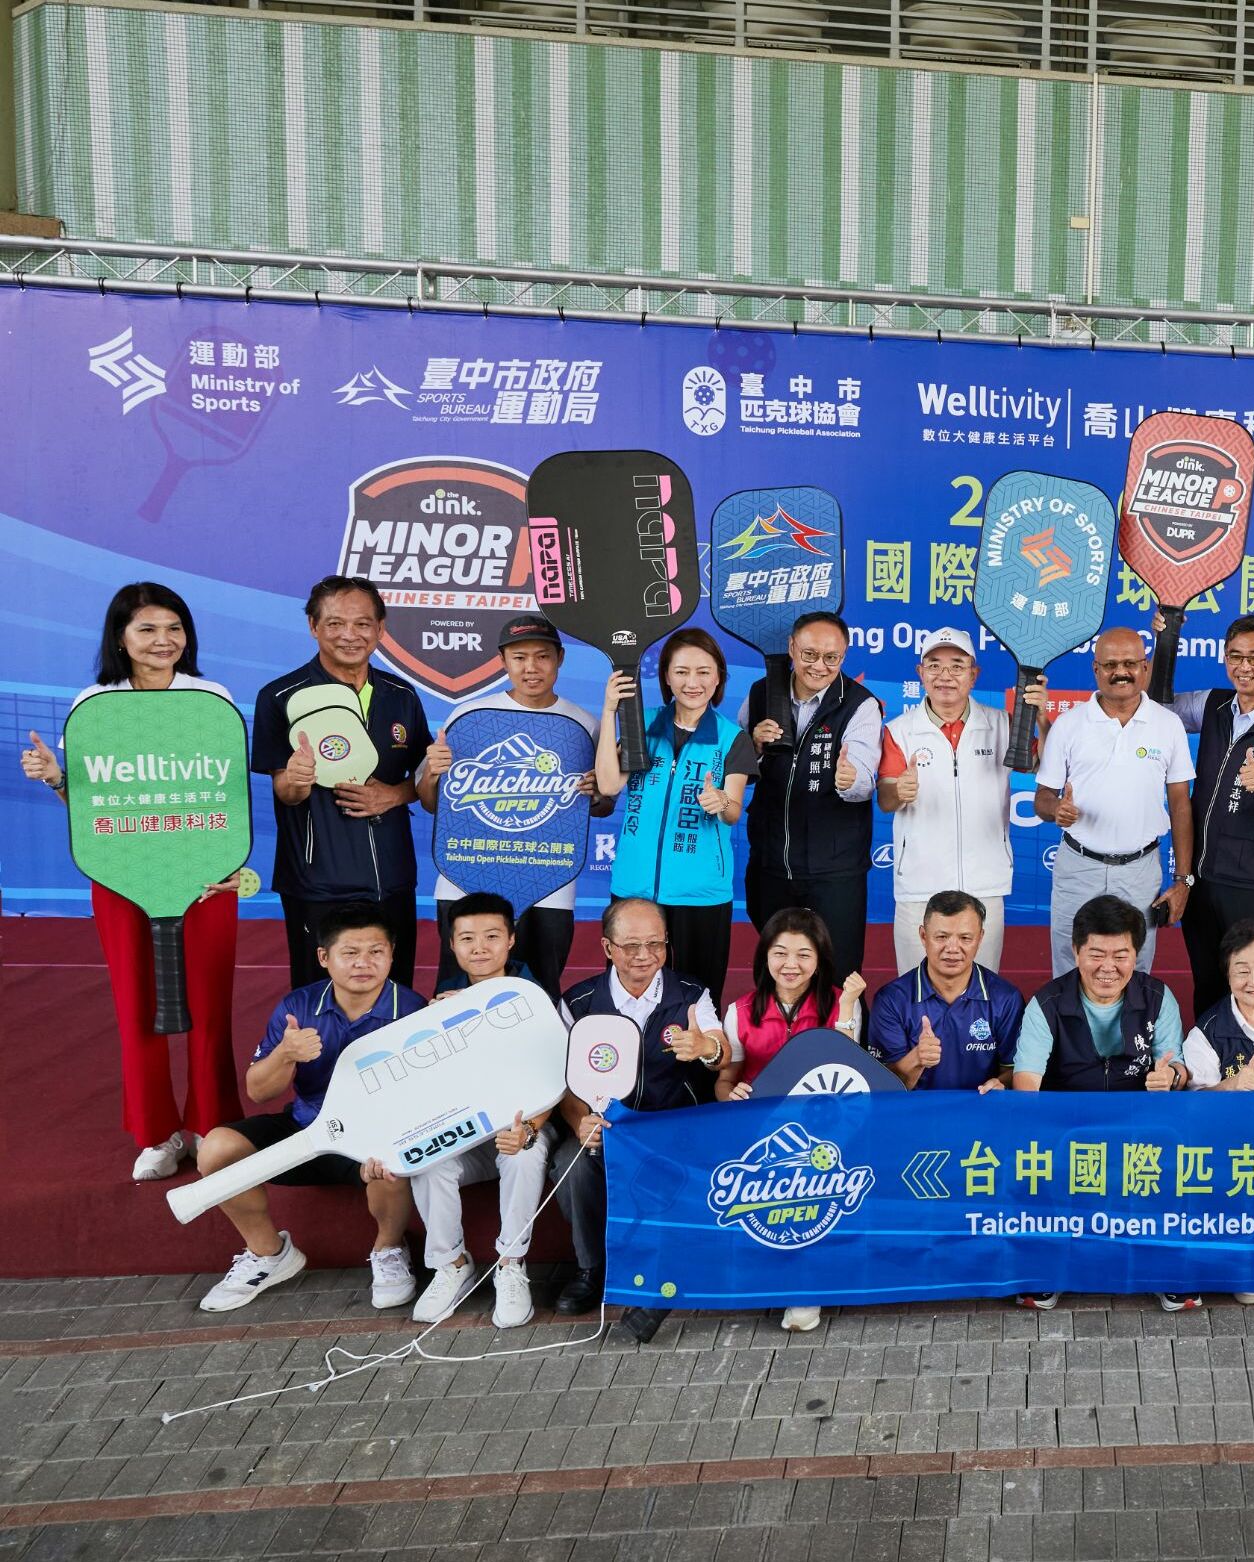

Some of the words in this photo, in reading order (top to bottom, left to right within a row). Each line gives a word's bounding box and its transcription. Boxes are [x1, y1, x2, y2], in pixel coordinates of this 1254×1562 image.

[189, 341, 280, 370] 運動部
[191, 374, 275, 396] Ministry
[279, 379, 300, 395] of
[420, 358, 603, 391] 臺中市政府
[740, 372, 862, 401] 臺中市
[191, 394, 261, 413] Sports
[416, 393, 466, 403] SPORTS
[440, 404, 491, 414] BUREAU
[490, 391, 600, 425] 運動局
[917, 382, 1062, 428] Welltivity
[740, 399, 861, 426] 匹克球協會
[690, 419, 719, 434] TXG
[740, 425, 775, 435] Taichung
[777, 427, 814, 436] Pickleball
[816, 428, 861, 438] Association
[922, 429, 1055, 447] 數位大健康生活平台
[1141, 468, 1218, 494] MINOR
[1136, 485, 1213, 509] LEAGUE
[1144, 504, 1187, 516] CHINESE
[1190, 510, 1223, 521] TAIPEI
[351, 519, 513, 558] MINOR
[988, 496, 1044, 566] MINISTRY
[1049, 498, 1077, 517] OF
[1074, 512, 1105, 586] SPORTS
[1166, 527, 1196, 540] DUPR
[346, 553, 508, 586] LEAGUE
[724, 562, 834, 592] 臺中市政府
[382, 592, 456, 606] HINESE
[465, 594, 533, 609] TAIPEI
[722, 590, 753, 599] SPORTS
[736, 594, 767, 604] BUREAU
[766, 580, 832, 605] 運動局
[1010, 591, 1069, 618] 運動部
[430, 620, 464, 628] POWERED
[422, 632, 483, 651] DUPR
[612, 635, 628, 643] USA
[83, 753, 231, 785] Welltivity
[450, 761, 580, 803] Taichung
[91, 791, 227, 806] 數位大健康生活平台
[495, 800, 540, 812] OPEN
[94, 813, 227, 835] 喬山健康科技
[477, 801, 503, 825] PICKLEBALL
[447, 838, 574, 854] 台中國際匹克球公開賽
[446, 852, 475, 864] Taichung
[476, 854, 495, 865] Open
[495, 855, 527, 865] Pickleball
[528, 856, 574, 868] Championship
[966, 1042, 997, 1051] OFFICIAL
[329, 1119, 339, 1133] USA
[714, 1164, 870, 1207] Taichung
[746, 1212, 778, 1241] PICKLEBALL
[801, 1200, 839, 1241] CHAMPIONSHIP
[767, 1204, 820, 1225] OPEN
[966, 1211, 1084, 1237] Taichung
[1091, 1211, 1156, 1238] Open
